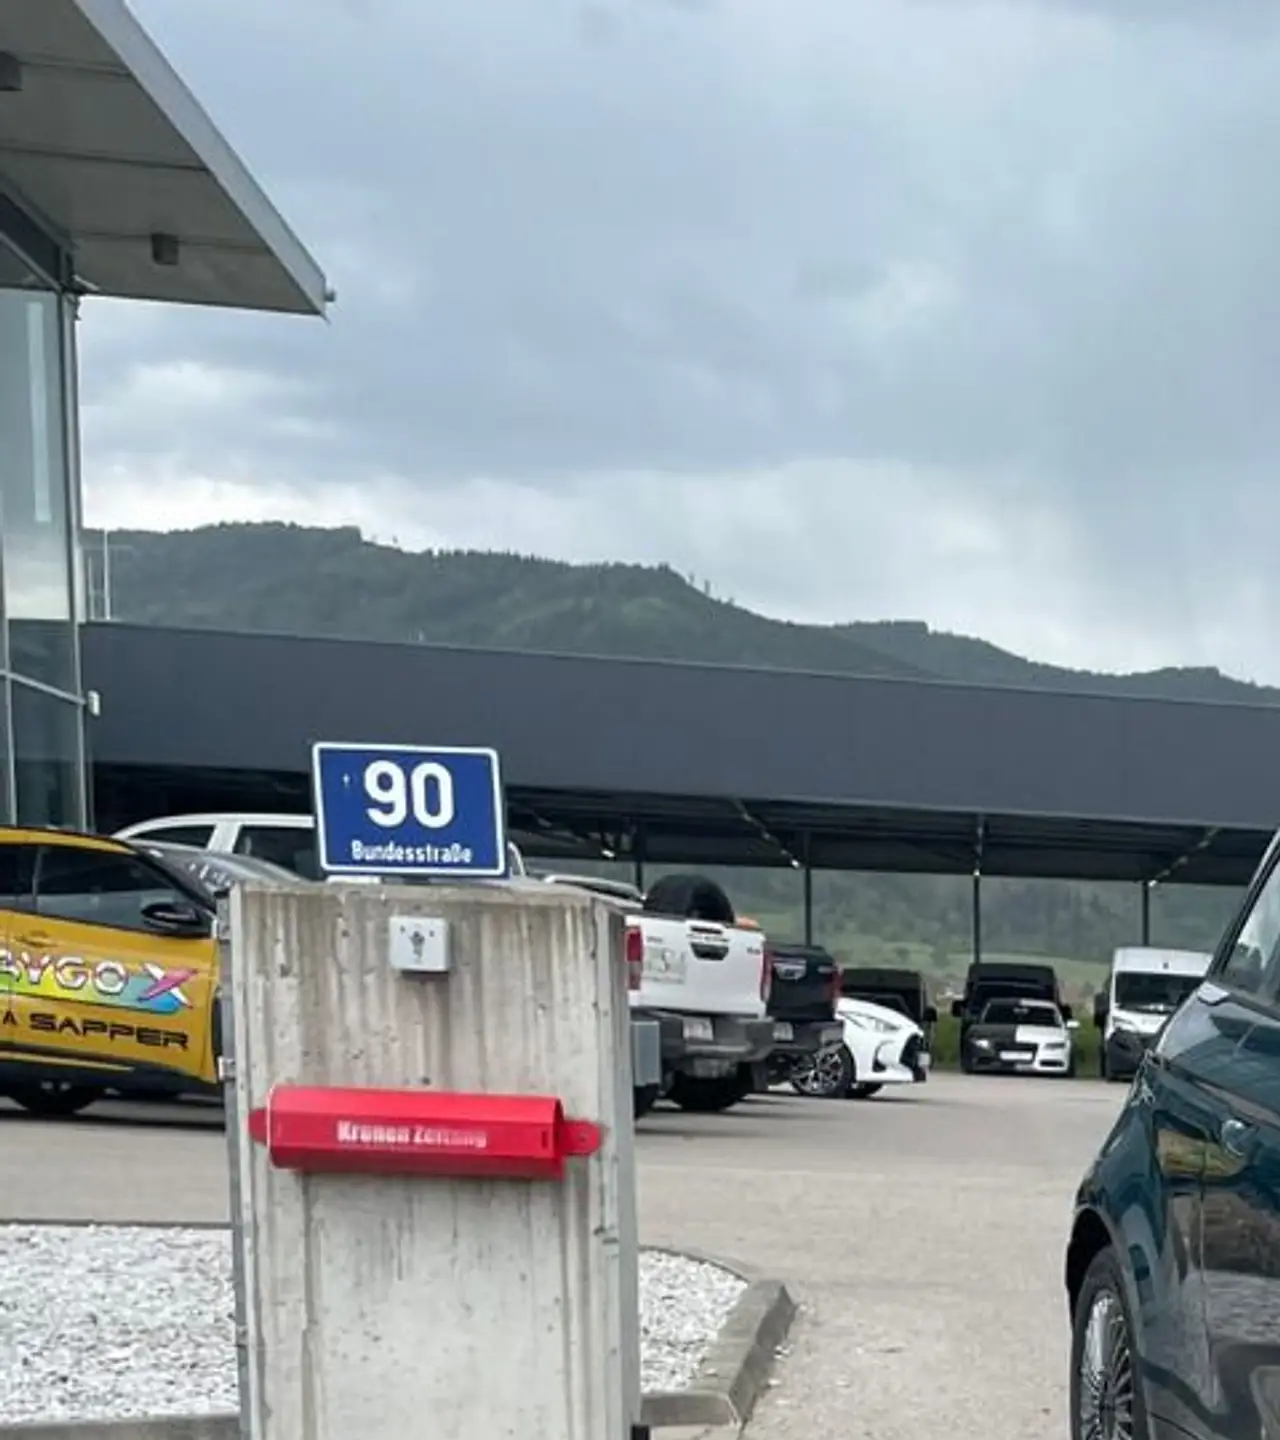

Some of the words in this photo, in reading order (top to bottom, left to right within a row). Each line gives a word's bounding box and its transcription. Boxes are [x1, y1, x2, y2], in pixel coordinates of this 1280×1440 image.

[364, 759, 455, 828] 90
[351, 839, 473, 863] Bundesstraße
[29, 1012, 190, 1050] SAPPER
[337, 1119, 410, 1145] Kronen
